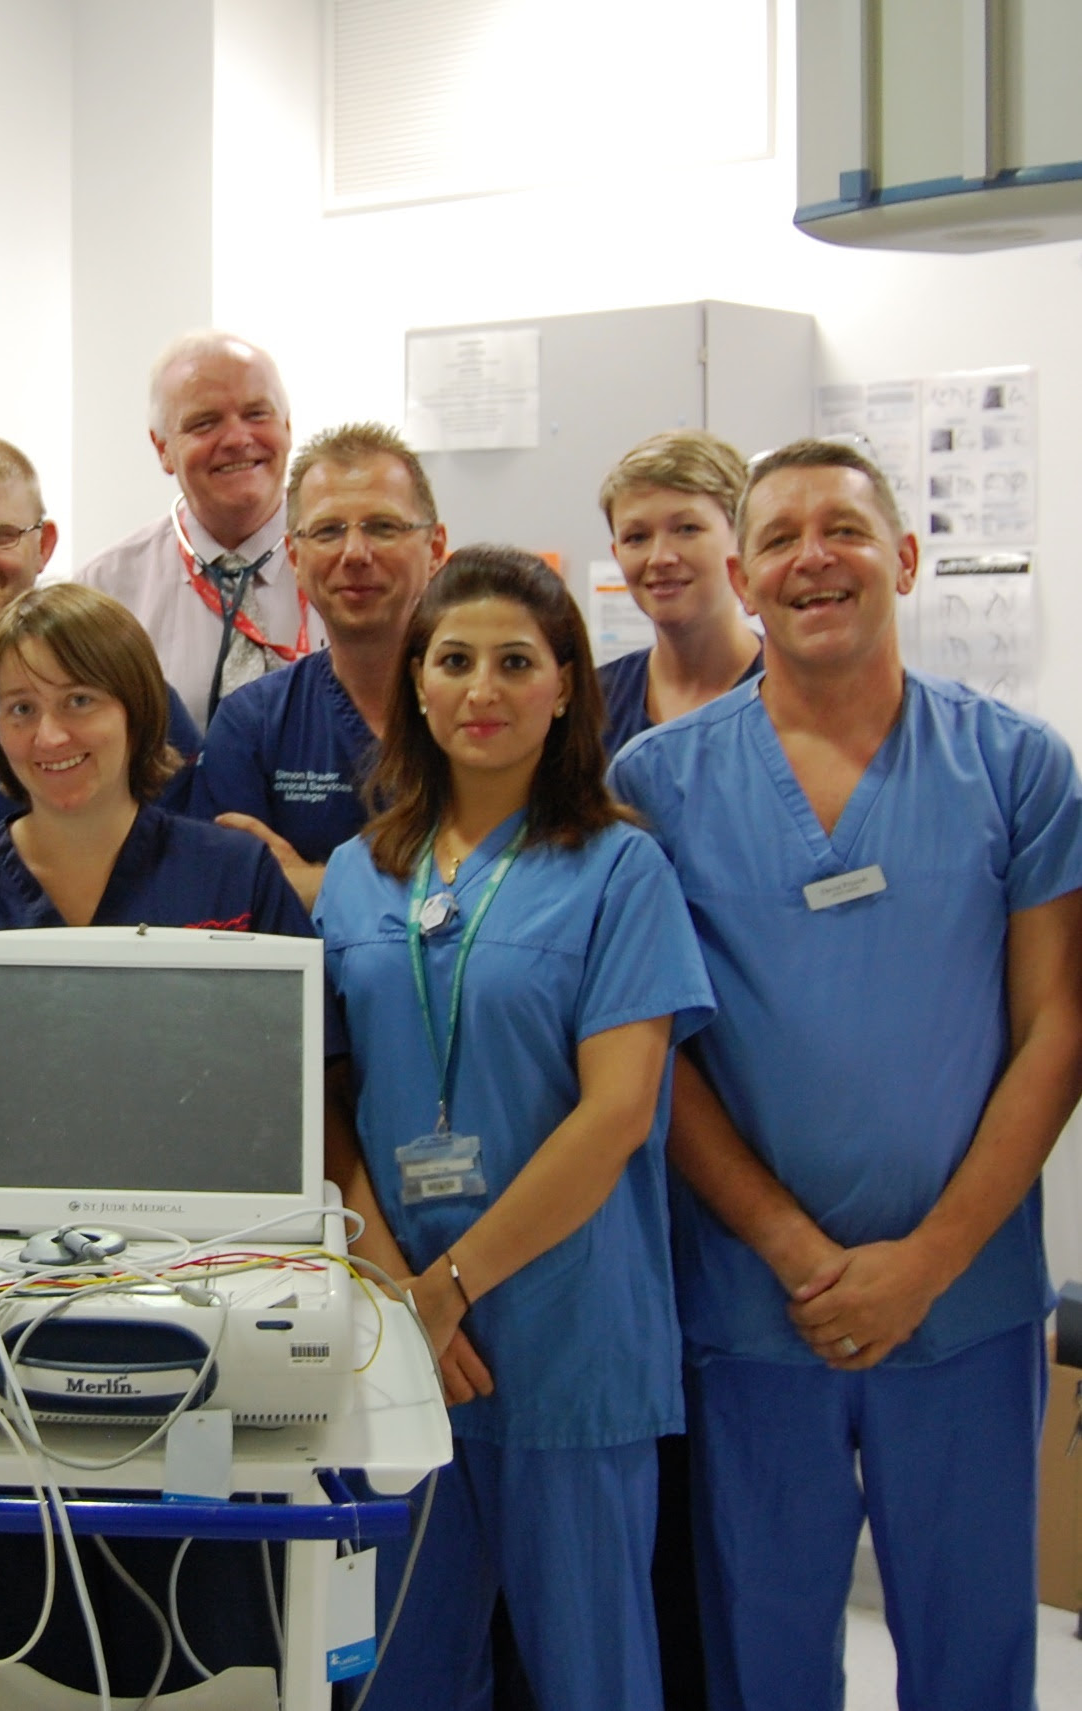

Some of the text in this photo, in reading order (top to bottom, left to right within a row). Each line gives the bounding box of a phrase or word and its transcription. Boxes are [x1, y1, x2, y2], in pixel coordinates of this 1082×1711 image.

[308, 781, 352, 793] Services
[284, 790, 327, 803] Manager
[131, 1202, 186, 1214] MEDICAL
